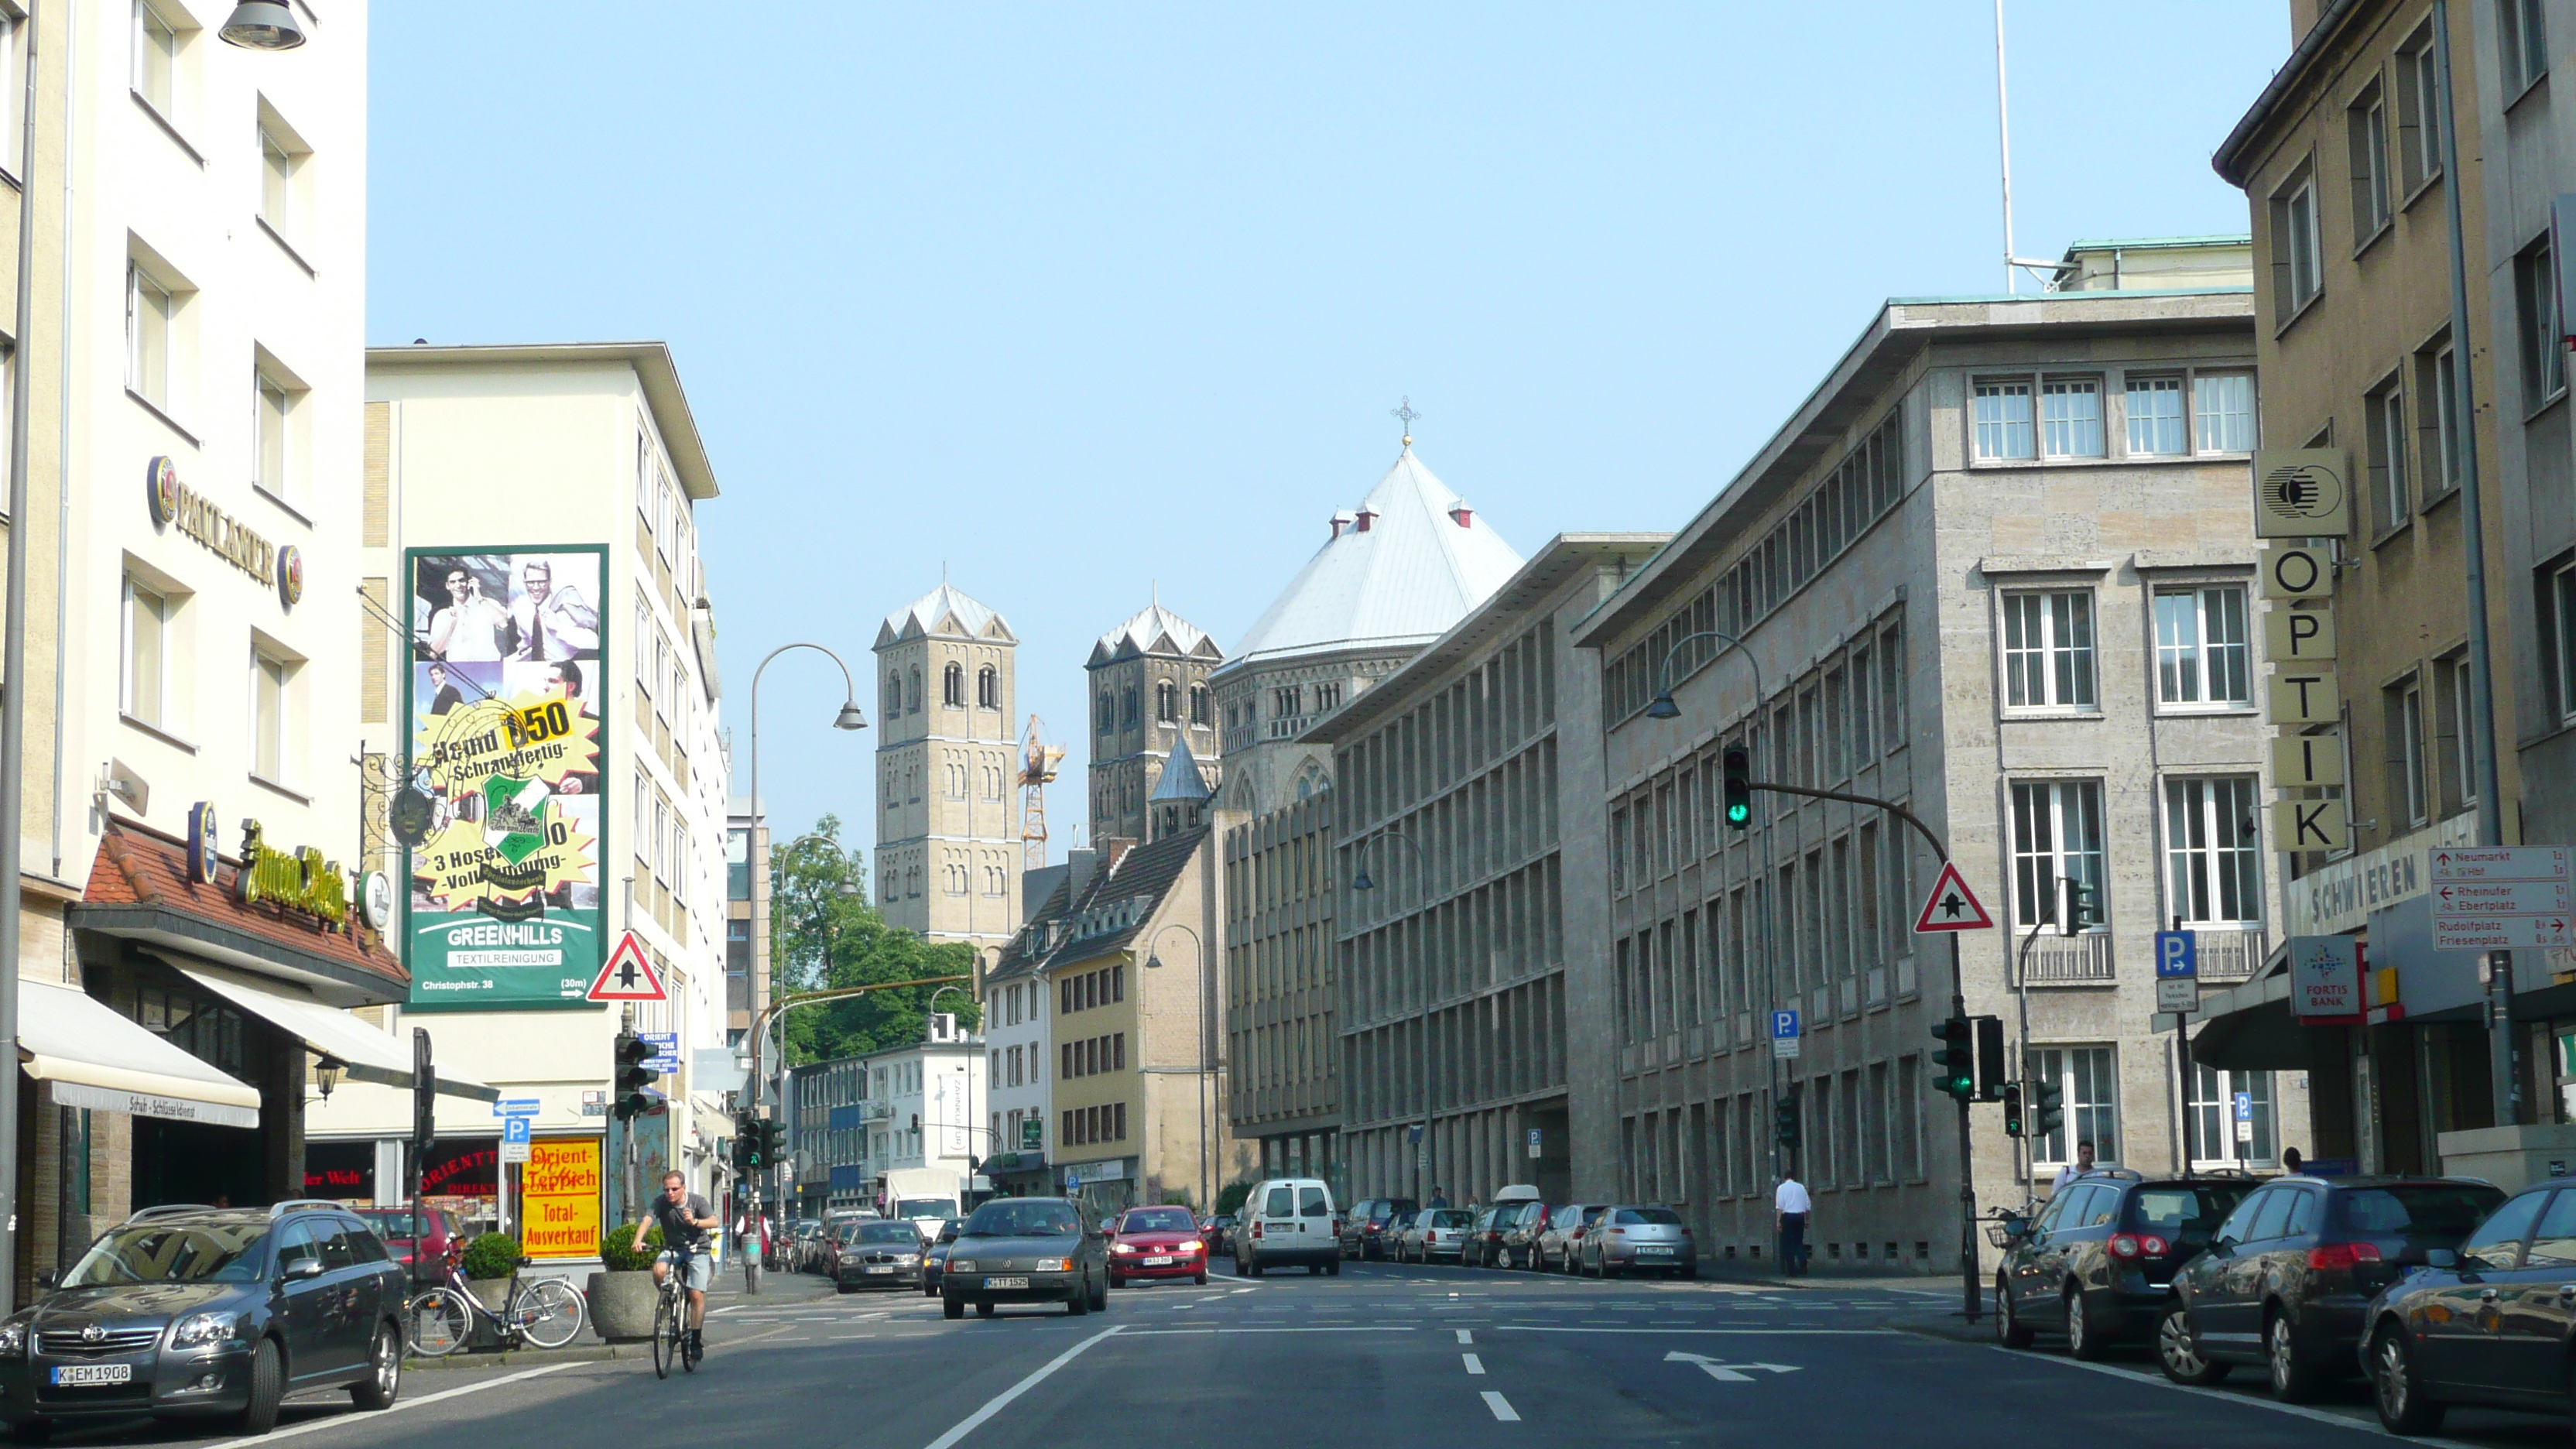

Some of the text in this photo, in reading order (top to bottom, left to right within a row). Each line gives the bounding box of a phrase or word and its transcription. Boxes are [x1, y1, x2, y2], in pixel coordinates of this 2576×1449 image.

[177, 481, 276, 587] PAULANER
[2274, 550, 2332, 846] OPTIK
[433, 729, 498, 769] Hemd
[433, 855, 447, 872] 3
[2455, 852, 2510, 862] Neumarkt
[2468, 867, 2485, 875] Hbf
[2312, 853, 2415, 924] SCHWIEREN
[2458, 886, 2512, 896] Rheinufer
[2459, 901, 2516, 911] Ebertplatz
[2439, 921, 2502, 932] Rudolfplatz
[447, 925, 563, 945] GREENHILLS
[2440, 935, 2509, 946] Friesenplatz
[457, 953, 554, 964] TEXTILREINIGUNG
[2164, 937, 2185, 971] P
[423, 978, 586, 991] Christophstr. 38 (30m)
[2307, 985, 2348, 995] FORTIS
[2311, 997, 2344, 1006] BANK
[1778, 1013, 1792, 1035] P
[2239, 1096, 2248, 1117] P
[509, 1121, 524, 1140] P
[530, 1147, 593, 1165] Orient-
[326, 1170, 361, 1185] Welt
[527, 1169, 596, 1190] Teppich
[447, 1183, 496, 1194] DIREKT
[543, 1203, 578, 1221] Total-
[526, 1226, 596, 1245] Ausverkauf
[988, 1278, 994, 1286] K
[1009, 1277, 1027, 1286] 1525
[59, 1366, 128, 1381] K EM 1908
